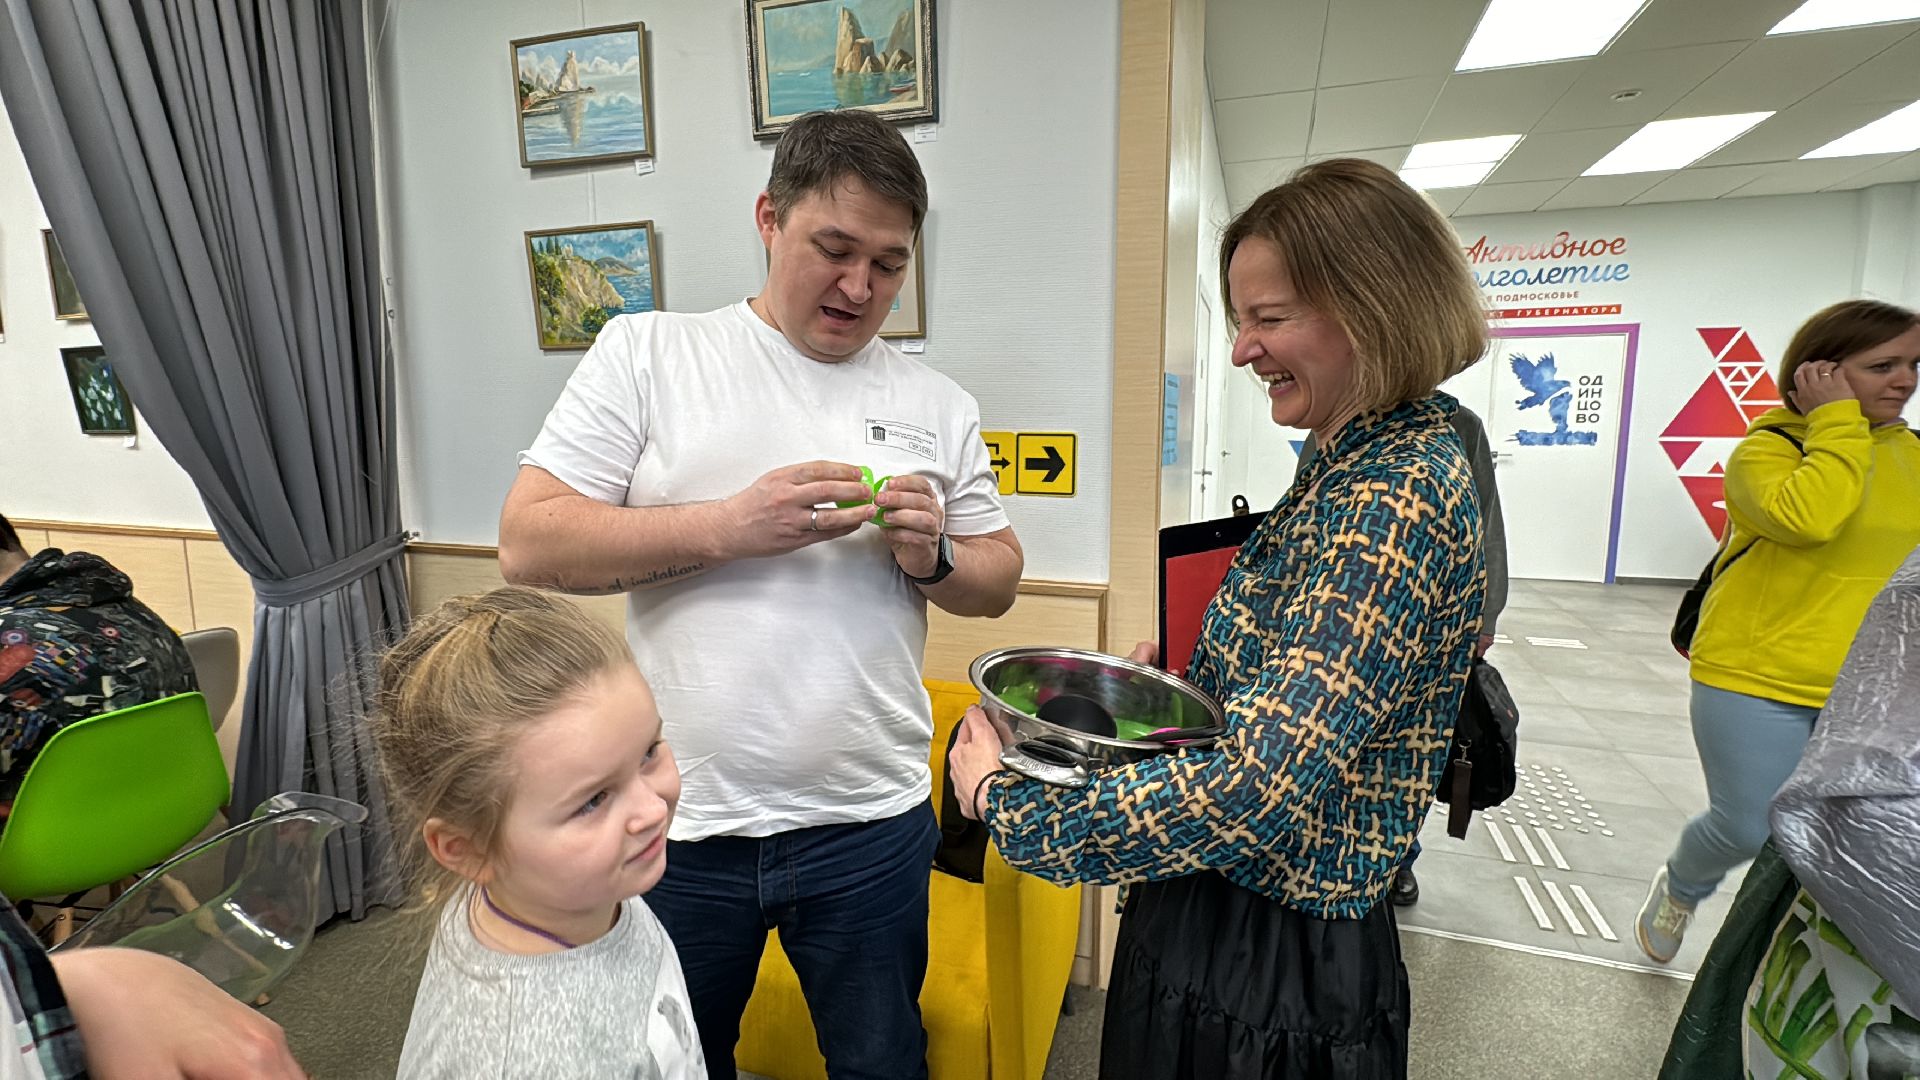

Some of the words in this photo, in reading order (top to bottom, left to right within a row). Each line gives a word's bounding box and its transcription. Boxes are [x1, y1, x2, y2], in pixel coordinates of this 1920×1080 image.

[1464, 231, 1628, 264] Активное
[1471, 262, 1631, 289] лголетие
[1496, 290, 1580, 302] ПОДМОСКОВЬЕ
[1516, 305, 1618, 318] ГУБЕРНАТОРА
[1578, 375, 1604, 387] ОД
[1578, 387, 1603, 399] ИН
[1577, 400, 1602, 412] ЦО
[1575, 413, 1600, 424] ВО
